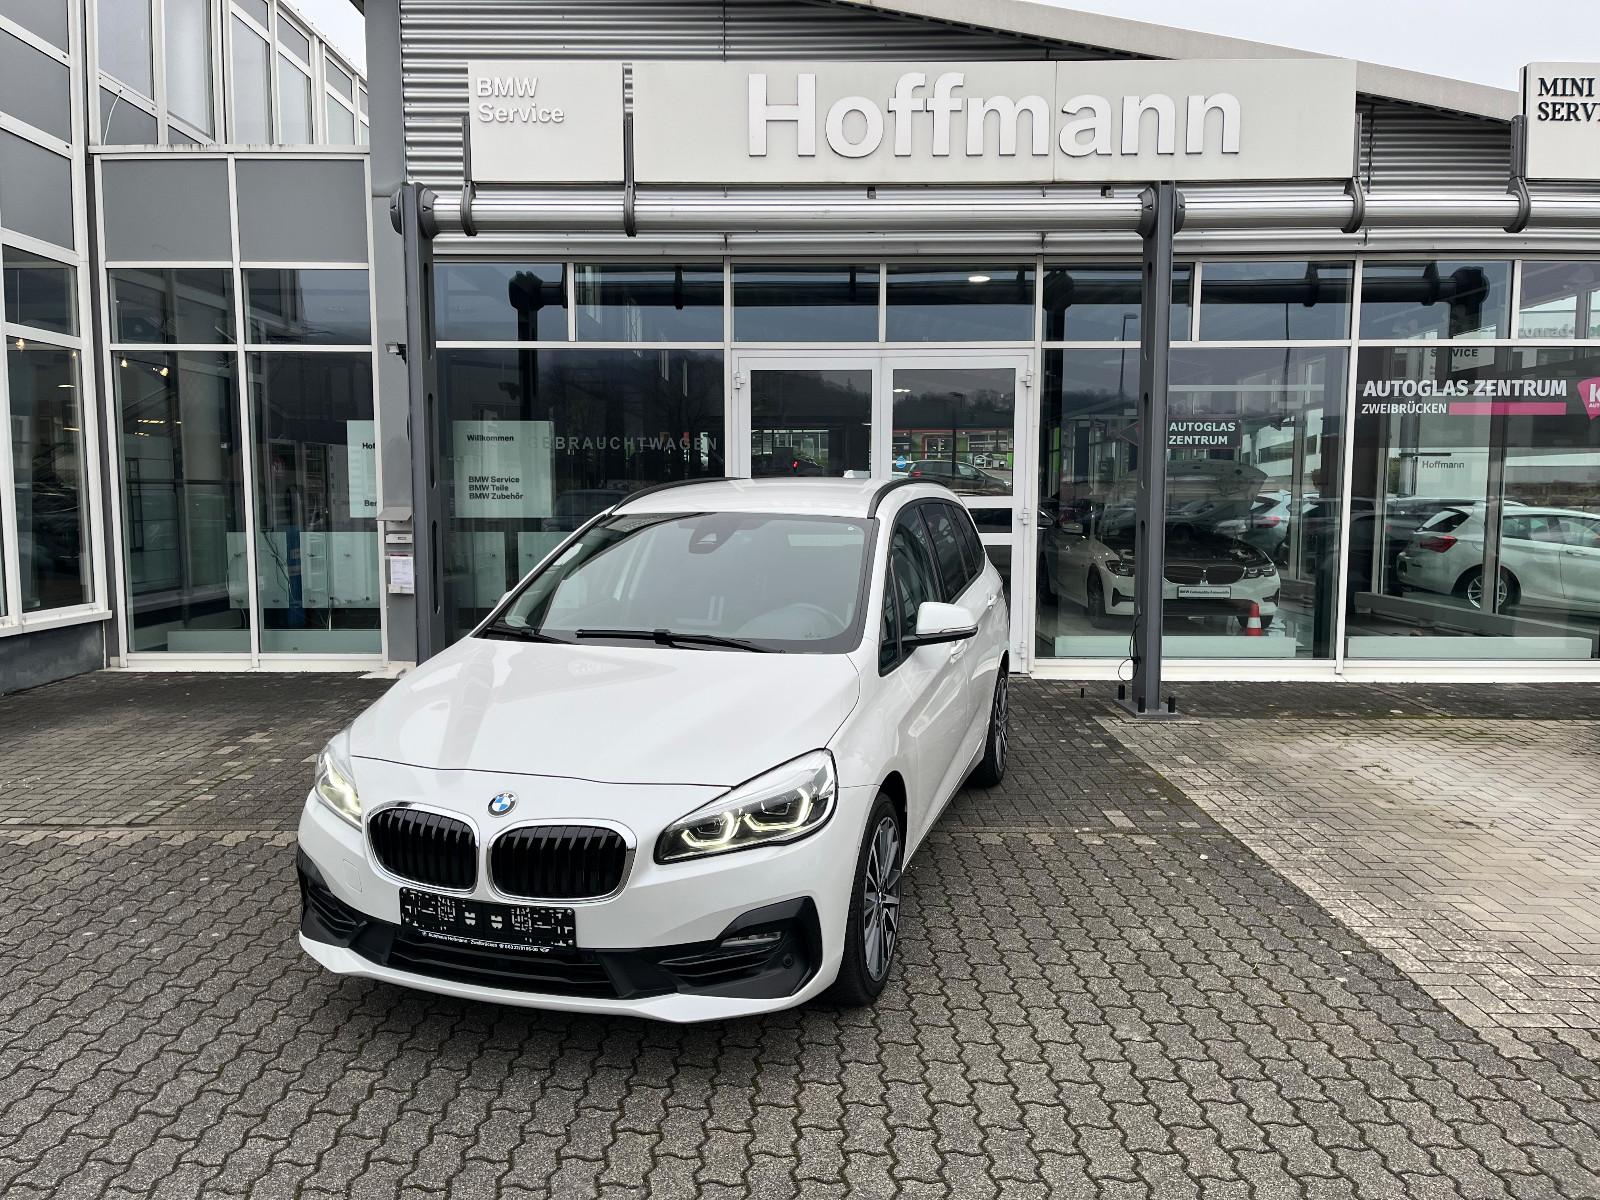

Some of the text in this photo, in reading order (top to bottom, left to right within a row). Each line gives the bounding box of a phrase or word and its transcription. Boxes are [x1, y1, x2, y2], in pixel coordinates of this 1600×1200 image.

[477, 77, 538, 97] BMW
[1538, 77, 1595, 97] MINI
[478, 103, 565, 124] Service
[748, 72, 1241, 158] Hoffmann
[1538, 101, 1600, 121] SERV
[1430, 348, 1478, 358] SVICE
[1363, 379, 1567, 397] AUTOGLAS ZENTRUM
[1361, 400, 1447, 414] ZWEIBRÜCKEN
[1169, 422, 1236, 432] AUTOGLAS
[467, 434, 514, 442] Willkommen
[1169, 435, 1228, 445] ZENTRUM
[1422, 460, 1465, 469] Hoffmann
[491, 492, 524, 500] Zubehör
